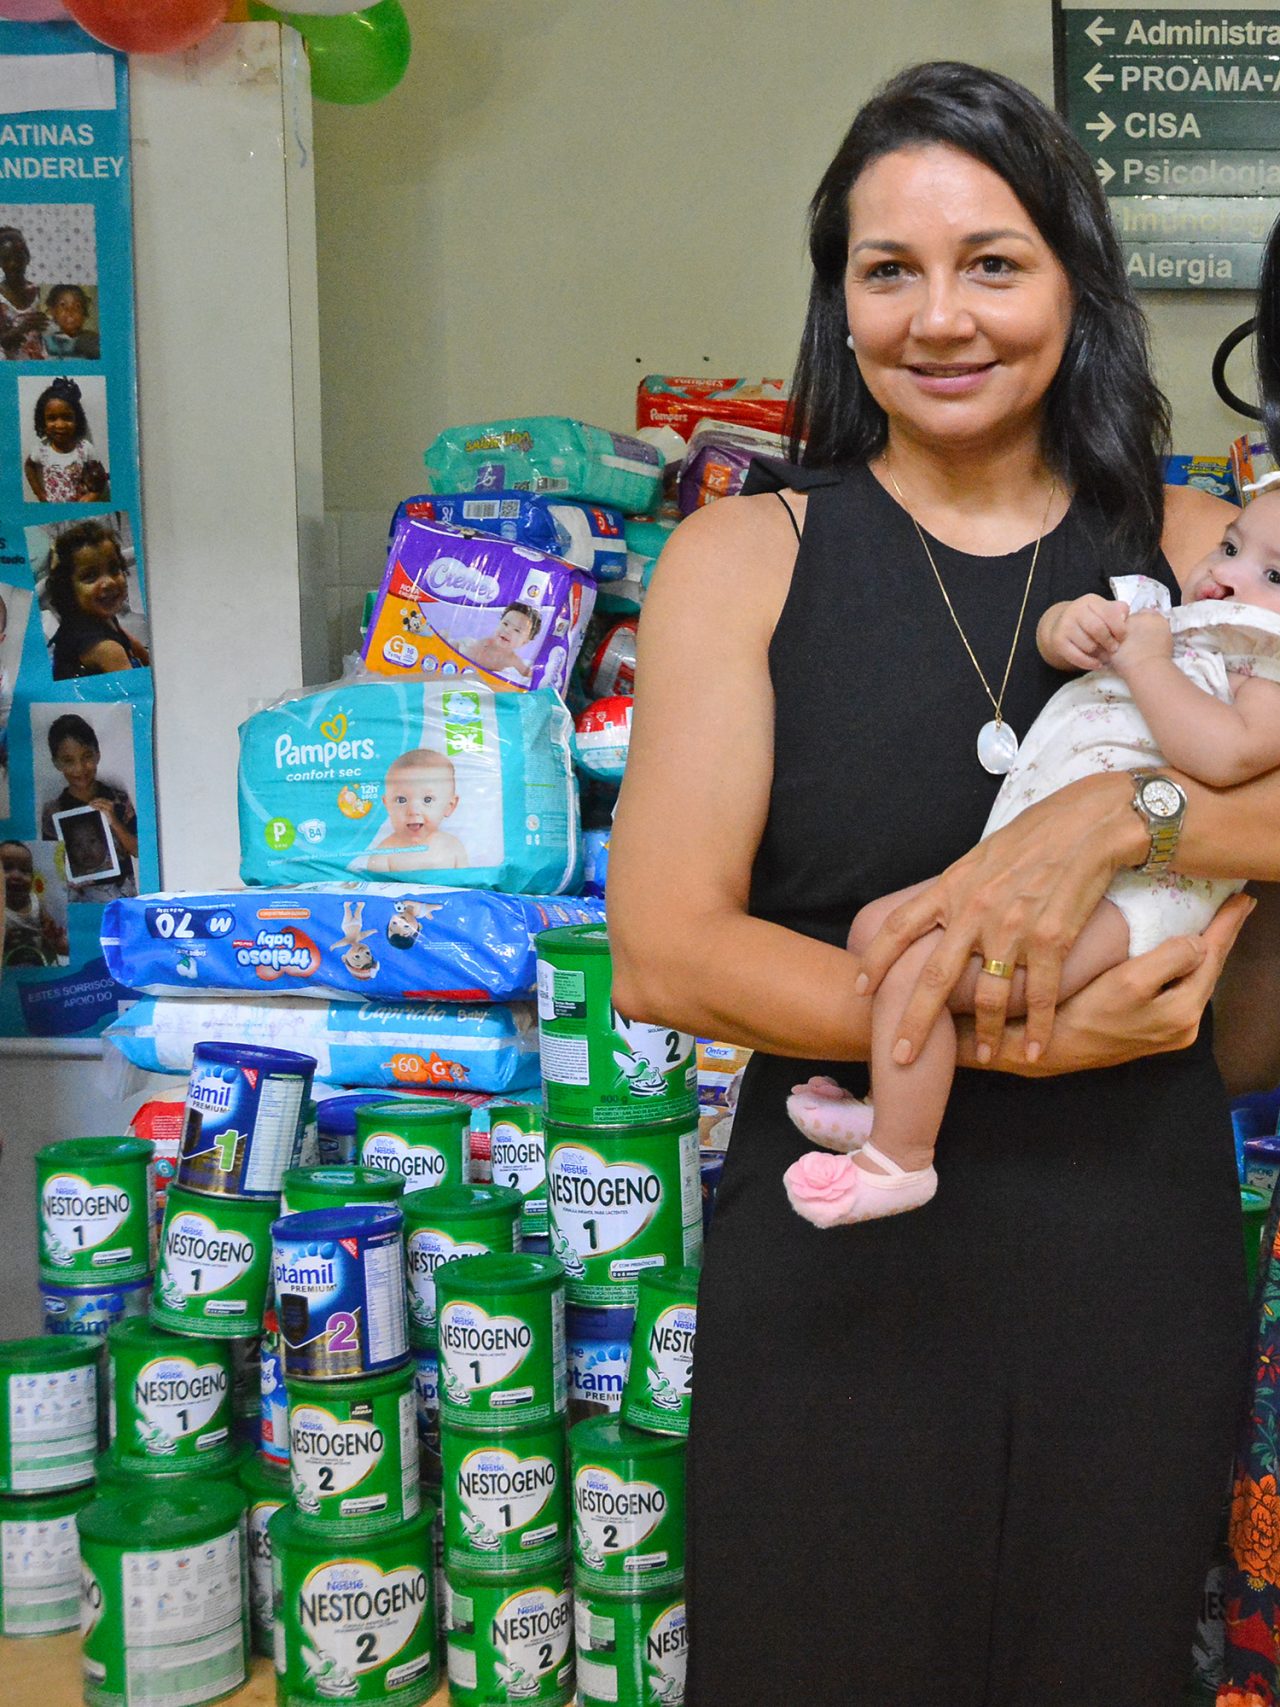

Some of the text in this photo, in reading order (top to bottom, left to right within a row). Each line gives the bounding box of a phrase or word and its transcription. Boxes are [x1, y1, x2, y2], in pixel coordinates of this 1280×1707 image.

[1124, 113, 1201, 139] CISA
[0, 156, 125, 179] NDERLEY
[1124, 207, 1271, 238] Imunolog
[1127, 253, 1233, 285] Alergia
[429, 563, 497, 598] Cremer
[275, 734, 375, 768] Pampers
[286, 768, 362, 782] confort sec
[273, 822, 286, 842] P
[155, 913, 232, 939] M 70
[256, 930, 294, 949] baby
[237, 948, 311, 970] treloso
[62, 977, 115, 996] SORRISOS
[665, 1031, 681, 1063] 2
[398, 1056, 447, 1075] 60 G
[214, 1129, 239, 1172] 1
[493, 1143, 546, 1164] ESTOGEN
[560, 1163, 588, 1175] Nestlé
[547, 1174, 660, 1206] NESTOGENO
[43, 1193, 130, 1216] NESTOGENO
[73, 1225, 84, 1246] 1
[583, 1219, 597, 1249] 1
[167, 1233, 254, 1263] NESTOGENO
[190, 1268, 201, 1291] 1
[273, 1263, 335, 1287] ptamil
[290, 1283, 336, 1293] PREMIUM
[326, 1312, 358, 1352] 2
[673, 1319, 696, 1329] Nestl
[440, 1325, 531, 1350] NESTOGENO
[469, 1360, 481, 1383] 1
[566, 1367, 623, 1393] ptam
[136, 1371, 227, 1404] NESTOGENO
[585, 1392, 622, 1401] PREMI
[176, 1410, 188, 1431] 1
[291, 1429, 384, 1456] NESTOGENO
[319, 1466, 334, 1491] 2
[458, 1463, 556, 1498] NESTOGENO
[575, 1489, 665, 1515] NESTOGENO
[499, 1504, 511, 1527] 1
[602, 1525, 619, 1549] 2
[300, 1572, 428, 1627] NESTOGENO
[492, 1603, 571, 1647] NESTOGEN
[356, 1632, 379, 1665] 2
[538, 1643, 553, 1671] 2
